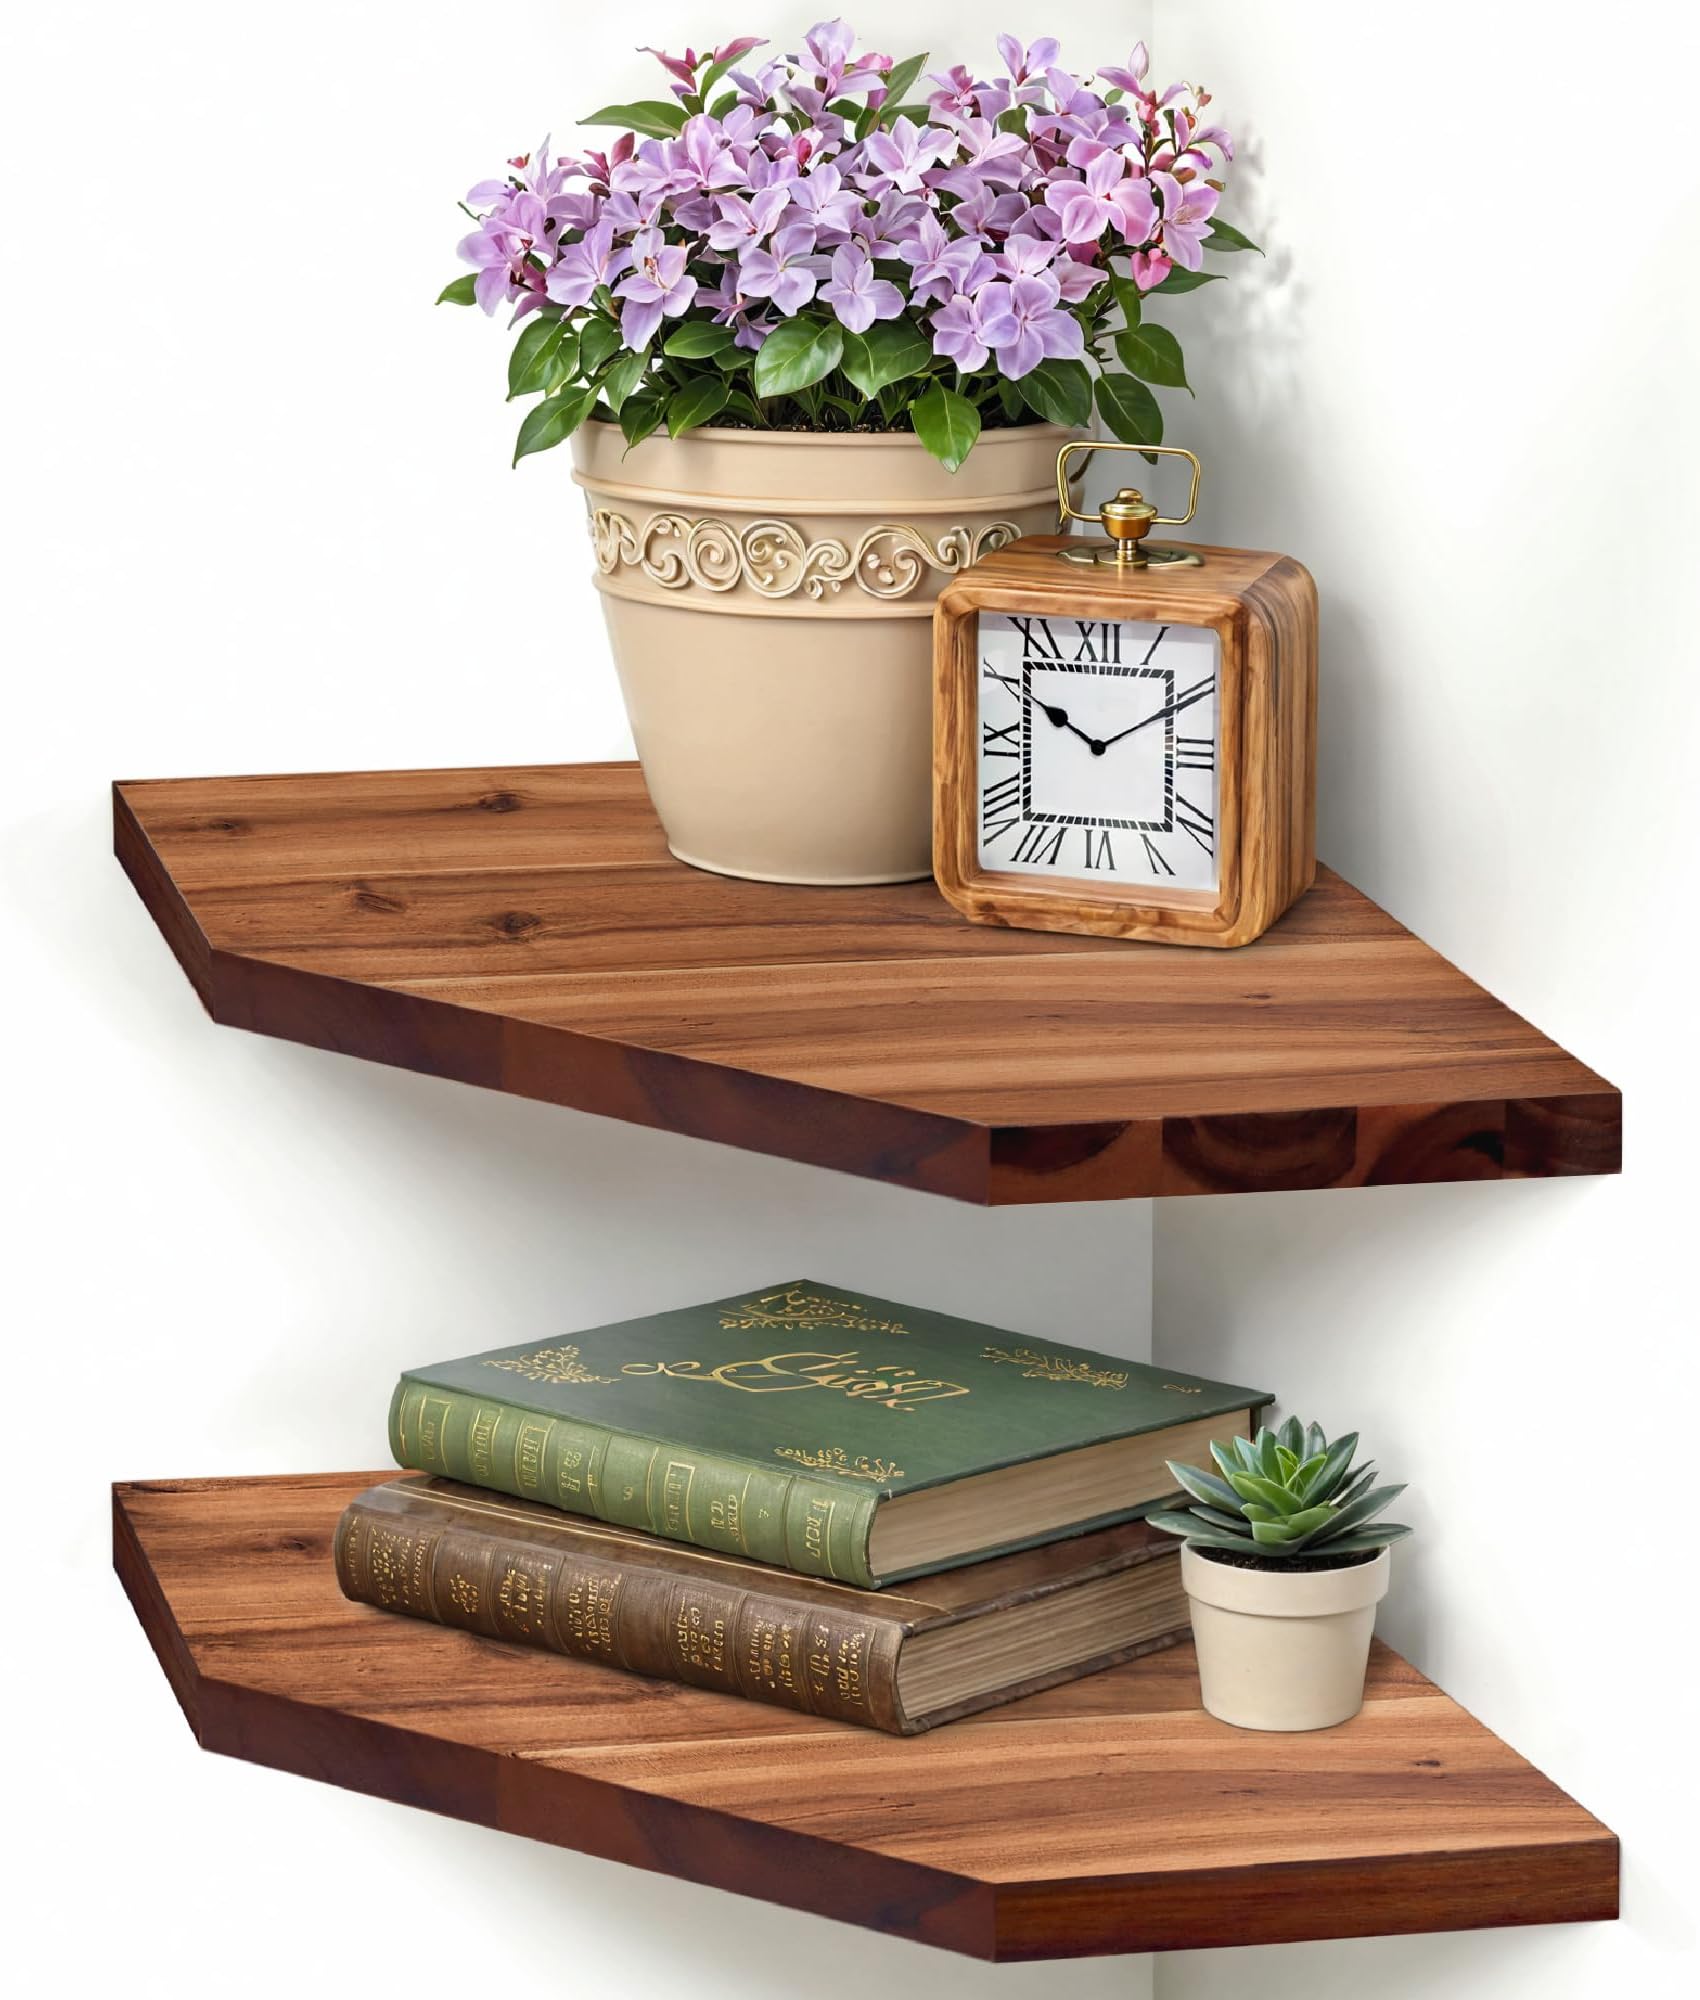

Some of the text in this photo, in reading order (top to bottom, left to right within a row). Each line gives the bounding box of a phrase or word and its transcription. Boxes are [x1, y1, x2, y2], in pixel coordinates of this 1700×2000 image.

[1008, 616, 1064, 659] XI
[1074, 620, 1122, 664] XII
[1140, 626, 1170, 665] I
[983, 657, 1020, 702] X
[983, 721, 1020, 760] IX
[1175, 735, 1215, 771] III
[983, 772, 1020, 847] VIII
[1008, 825, 1068, 865] VII
[1083, 829, 1117, 871] VI
[1139, 833, 1176, 876] V
